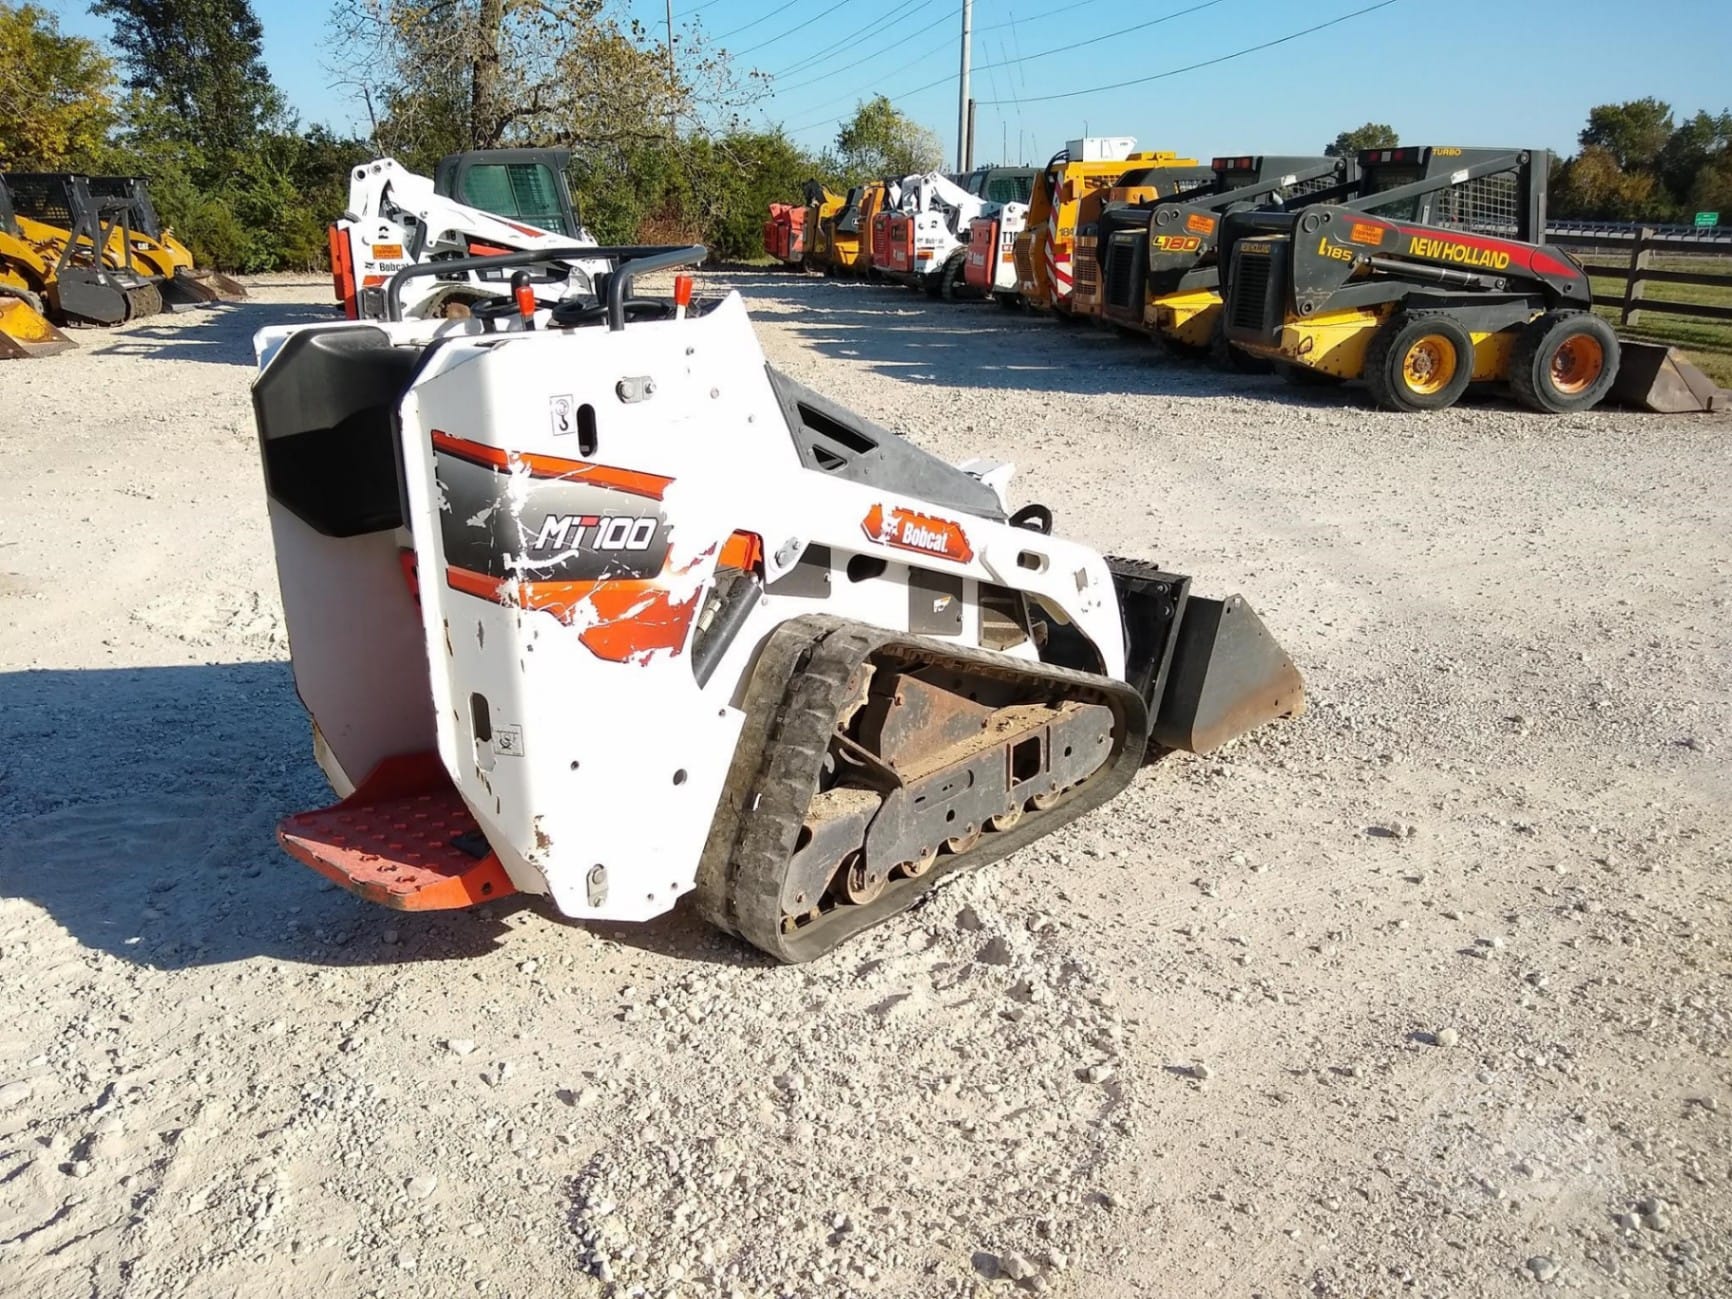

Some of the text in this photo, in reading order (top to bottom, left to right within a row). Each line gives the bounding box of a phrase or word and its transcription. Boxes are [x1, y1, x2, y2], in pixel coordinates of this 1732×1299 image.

[1431, 148, 1462, 157] TURBO
[1153, 235, 1202, 251] L180
[1318, 236, 1353, 262] L185
[1409, 236, 1510, 270] NEW HOLLAND
[533, 514, 658, 551] MT100
[902, 521, 948, 553] Bobcat
